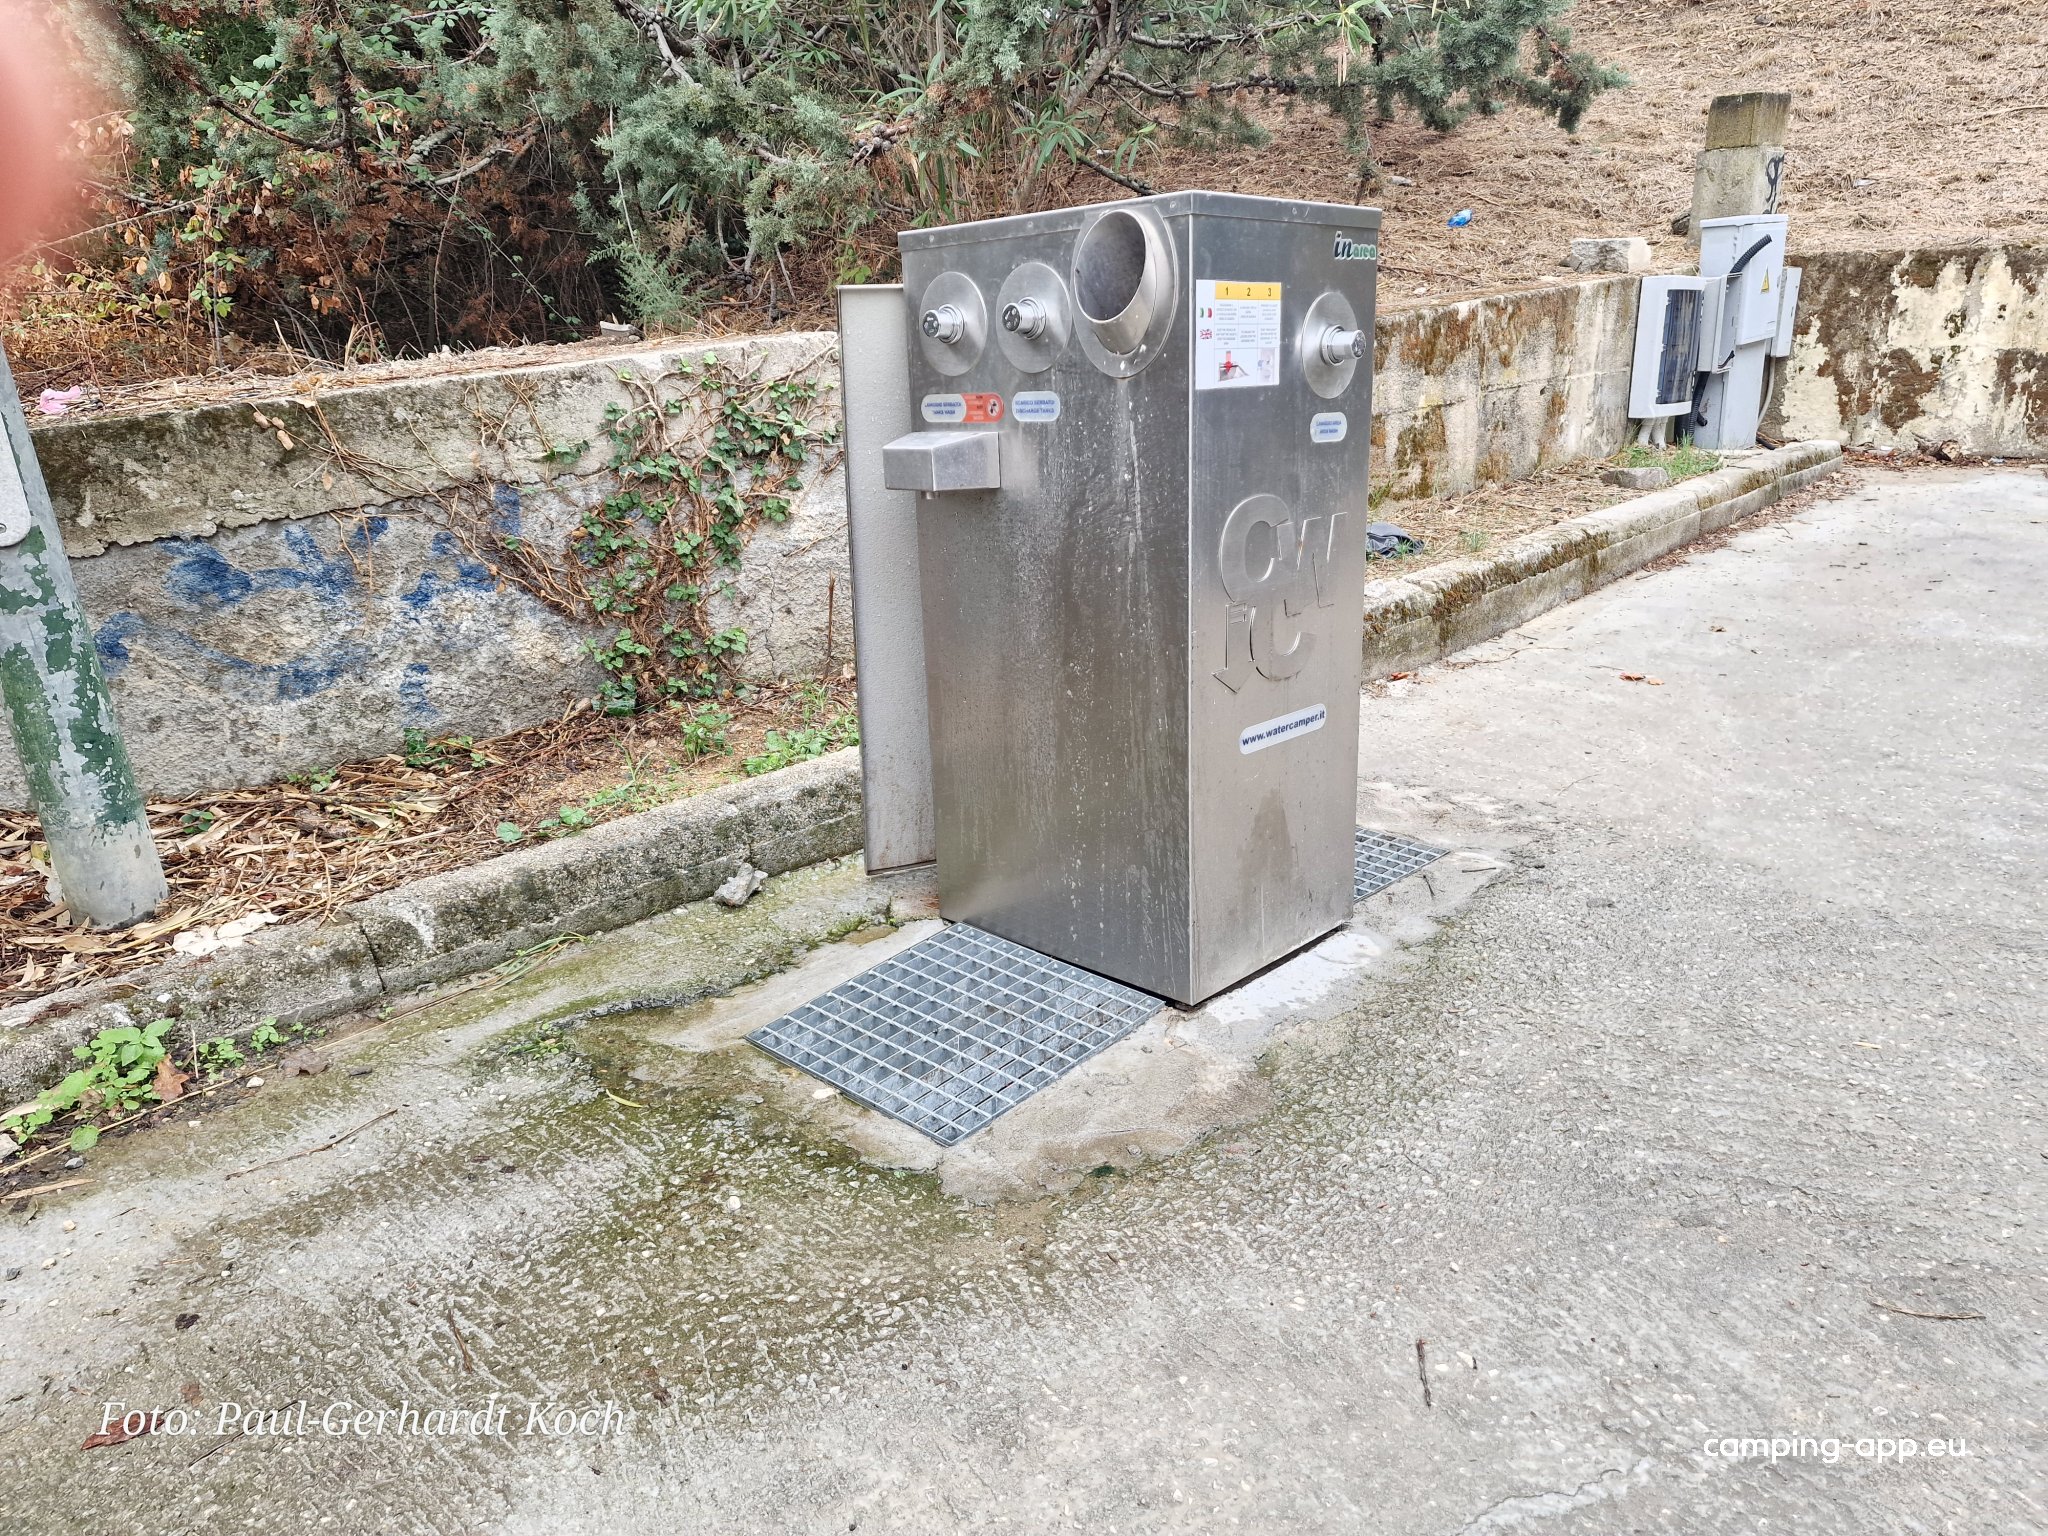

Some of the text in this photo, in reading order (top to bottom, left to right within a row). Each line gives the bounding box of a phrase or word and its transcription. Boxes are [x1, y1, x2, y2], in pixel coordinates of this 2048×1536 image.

[1246, 287, 1251, 297] 2
[1267, 287, 1272, 297] 3
[1242, 709, 1326, 746] www.watercamper.it
